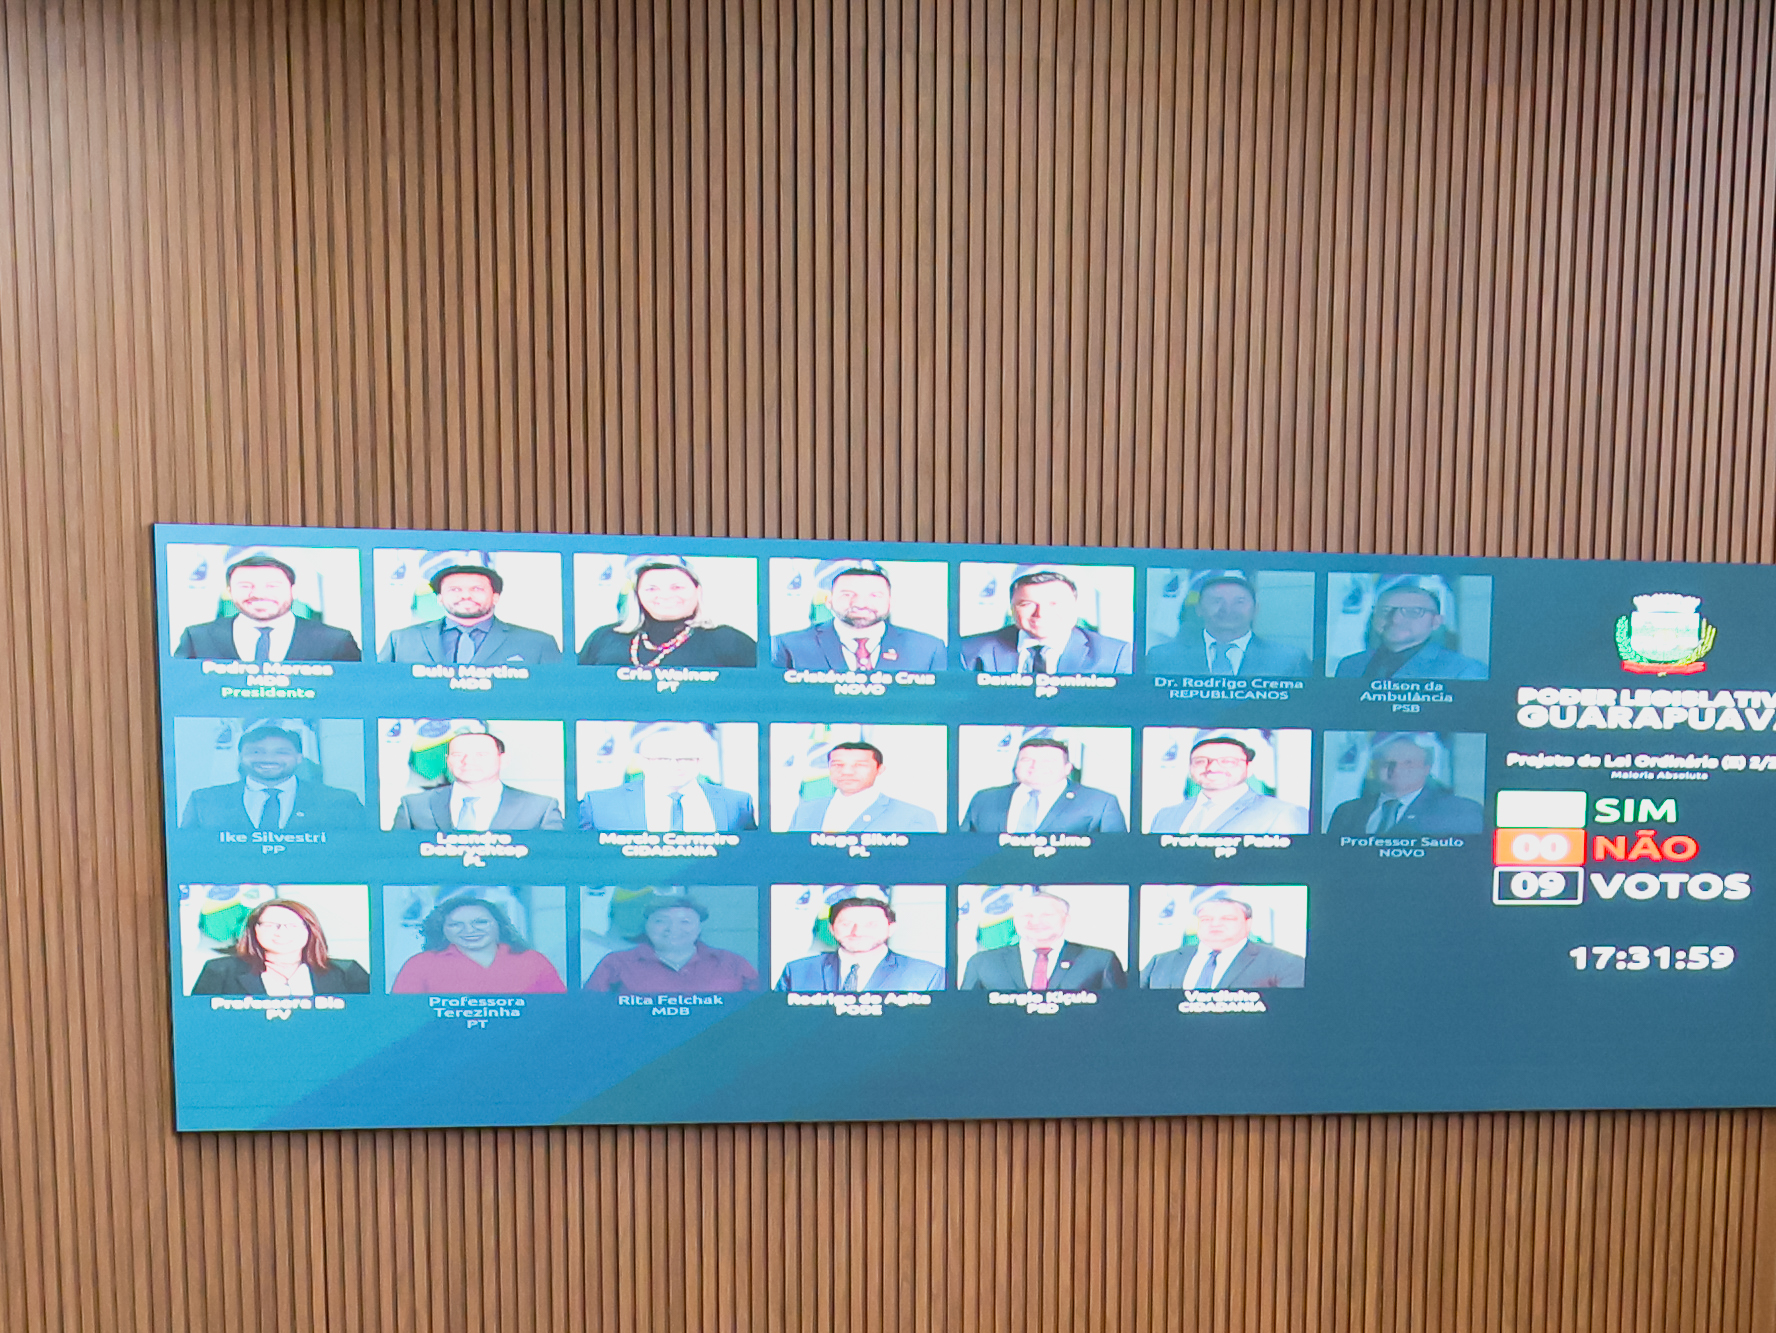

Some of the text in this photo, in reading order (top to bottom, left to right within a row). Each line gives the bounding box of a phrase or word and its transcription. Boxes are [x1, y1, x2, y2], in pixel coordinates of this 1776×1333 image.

[617, 667, 652, 681] Cris
[895, 672, 935, 686] Cruz
[977, 673, 1033, 687] Danilo
[247, 675, 290, 687] MDB
[450, 677, 492, 690] MDB
[657, 680, 680, 693] PT
[1154, 677, 1304, 690] Dr. Rodrigo Crema
[1371, 680, 1444, 692] Gilson da
[222, 686, 316, 699] Presidente
[835, 683, 886, 696] NOVO
[1169, 689, 1289, 701] REPUBLICANOS
[1517, 686, 1618, 706] PODER
[1360, 690, 1453, 703] Ambulância
[1392, 703, 1421, 714] PSB
[1506, 751, 1575, 770] Projeto
[1577, 754, 1602, 768] de
[1604, 753, 1632, 769] Lei
[1634, 753, 1719, 770] Ordinário
[1611, 770, 1709, 781] Maioria Absoluta
[1594, 797, 1678, 823] SIM
[219, 831, 327, 844] Ike Silvestri
[436, 832, 512, 846] Leandro
[999, 833, 1092, 848] Paulo Lima
[1160, 834, 1241, 849] Professor
[1340, 836, 1464, 848] Professor Saulo
[262, 843, 286, 855] PP
[622, 844, 718, 858] CIDADANIA
[848, 844, 871, 858] PL
[1511, 829, 1700, 862] 00 NÃO
[1379, 848, 1425, 859] NOVO
[1510, 871, 1752, 901] 09 VOTOS
[1569, 945, 1735, 971] 17:31:59
[210, 996, 312, 1012] Professora
[429, 996, 525, 1008] Professora
[618, 995, 723, 1006] Rita Felchak
[1178, 1001, 1267, 1013] CIDADANIA
[266, 1008, 292, 1021] PV
[434, 1007, 521, 1019] Terezinha
[651, 1006, 689, 1017] MDB
[835, 1004, 883, 1017] PODE
[466, 1019, 488, 1030] PT
